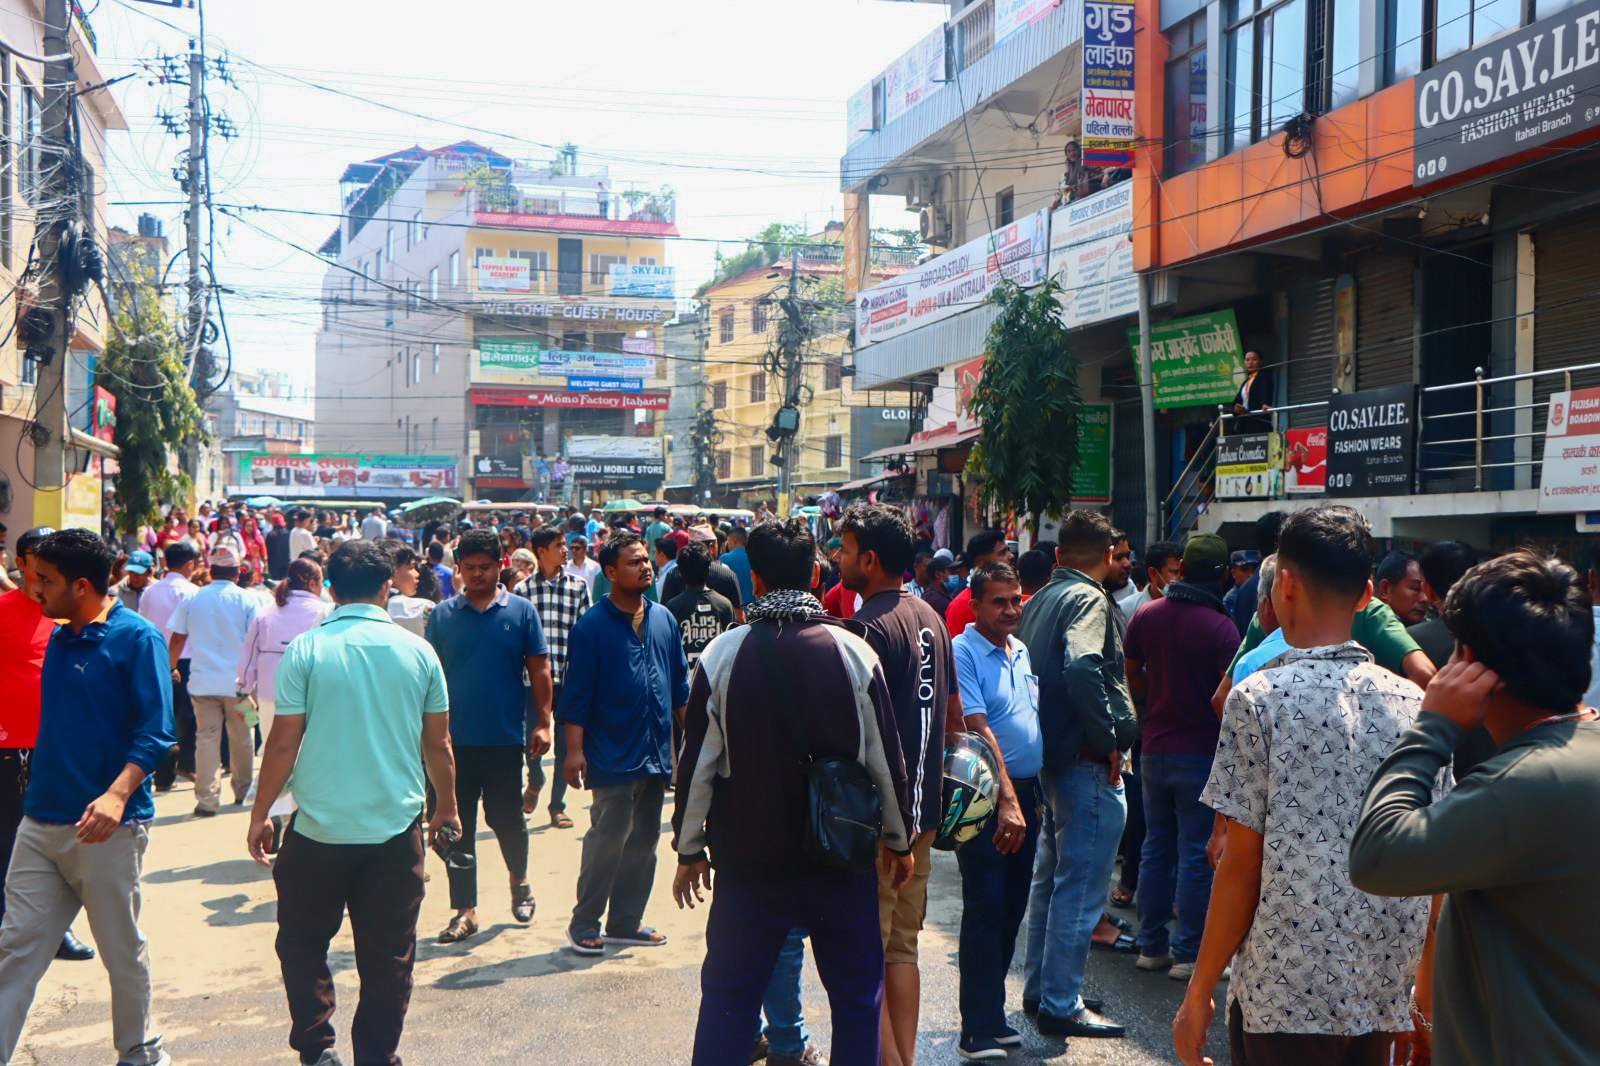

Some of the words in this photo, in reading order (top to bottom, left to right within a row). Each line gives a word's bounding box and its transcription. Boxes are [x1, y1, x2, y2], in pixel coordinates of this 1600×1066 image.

[1085, 2, 1134, 40] गुड
[1085, 41, 1134, 68] लाईफ
[1086, 90, 1133, 120] मेनपावर
[1460, 106, 1519, 144] FASHION
[1523, 84, 1574, 121] WEARS
[1086, 120, 1110, 135] पहिलो
[1112, 124, 1133, 136] तल्ला
[1515, 122, 1540, 142] Itahari
[1542, 113, 1572, 132] Branch
[631, 266, 651, 275] SKY
[654, 266, 674, 276] NET
[920, 264, 948, 290] ABROAD
[948, 253, 971, 278] STUDY
[890, 286, 908, 304] GLOBAL
[914, 297, 933, 318] JAPAN
[938, 292, 946, 306] UK
[952, 275, 986, 302] AUSTRALIA
[482, 302, 554, 316] WELCOME
[562, 306, 608, 319] GUEST
[615, 308, 661, 322] HOUSE
[579, 394, 620, 406] Factory
[622, 395, 656, 406] Itahari
[1571, 398, 1600, 410] FUJISAN
[1330, 402, 1410, 432] CO.SAY.LEE.
[1238, 444, 1266, 461] Cosmetics
[1334, 438, 1369, 454] FASHION
[1370, 436, 1402, 450] WEARS
[1563, 444, 1586, 460] सम्पर्क
[318, 455, 360, 469] संसार
[1383, 454, 1403, 464] Branch
[1581, 465, 1597, 476] इटहरी
[691, 612, 715, 627] Los
[680, 619, 722, 647] Angel
